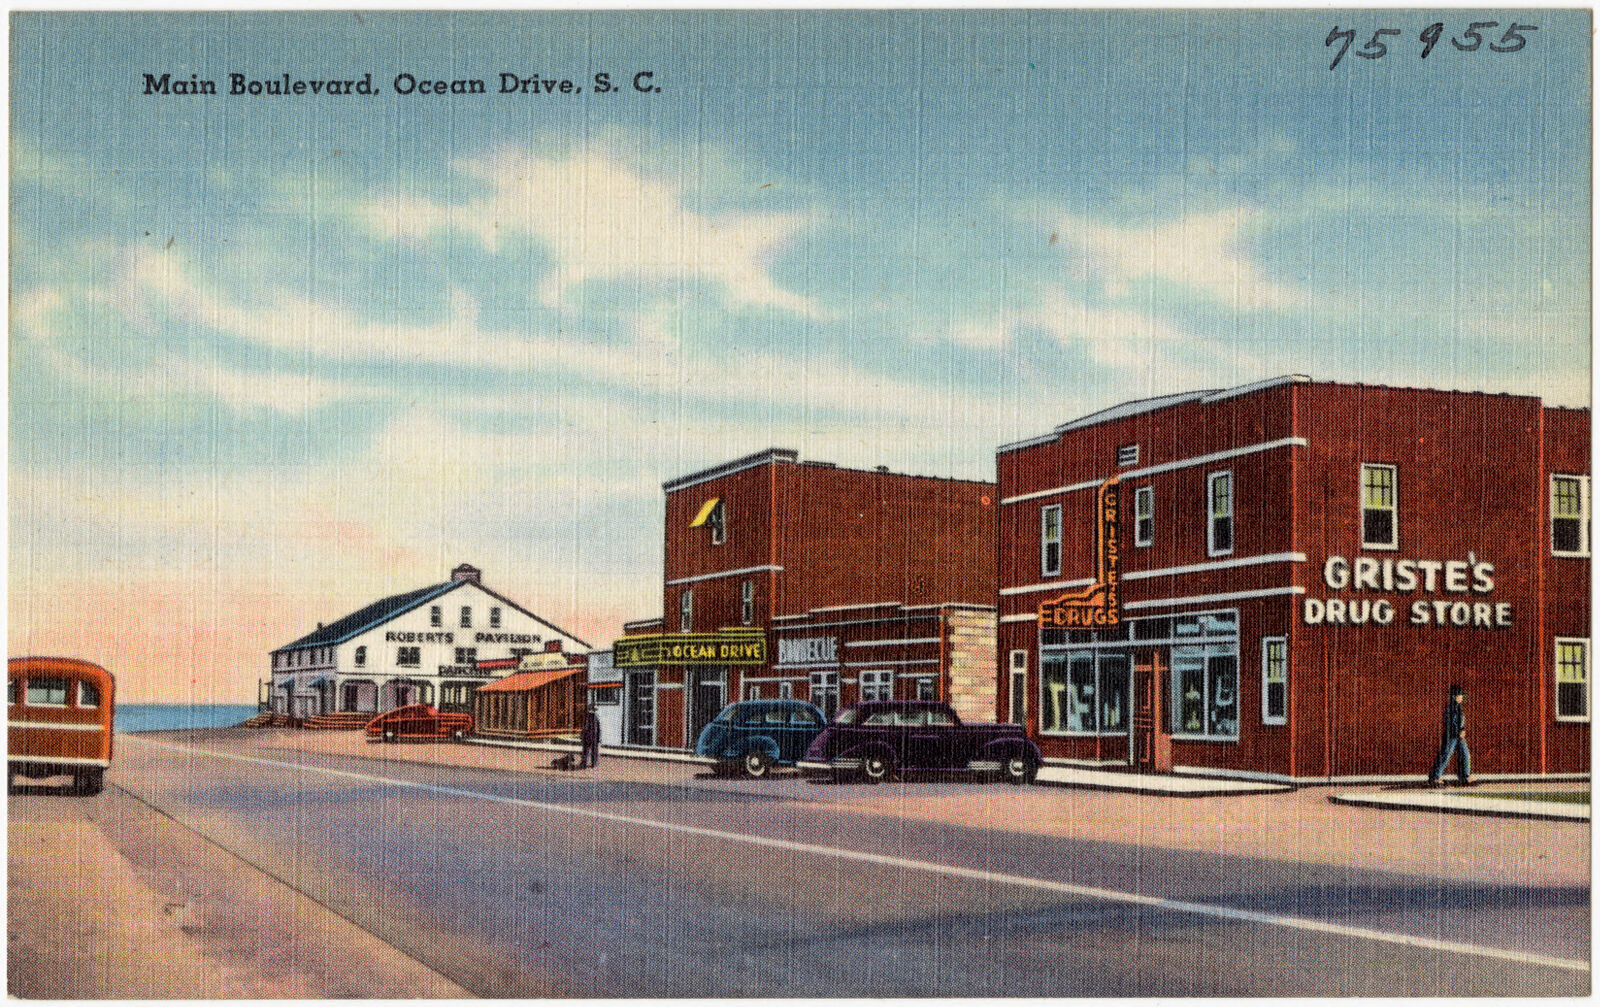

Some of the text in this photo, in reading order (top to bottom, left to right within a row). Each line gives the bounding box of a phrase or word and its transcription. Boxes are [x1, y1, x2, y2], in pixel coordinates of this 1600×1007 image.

[1324, 551, 1495, 592] GRISTE'S
[1054, 608, 1118, 626] DRUGS
[1304, 598, 1513, 629] DRUG STORE
[386, 631, 541, 643] ROBERTS PAVILION
[672, 643, 760, 659] OCEAN DRIVE
